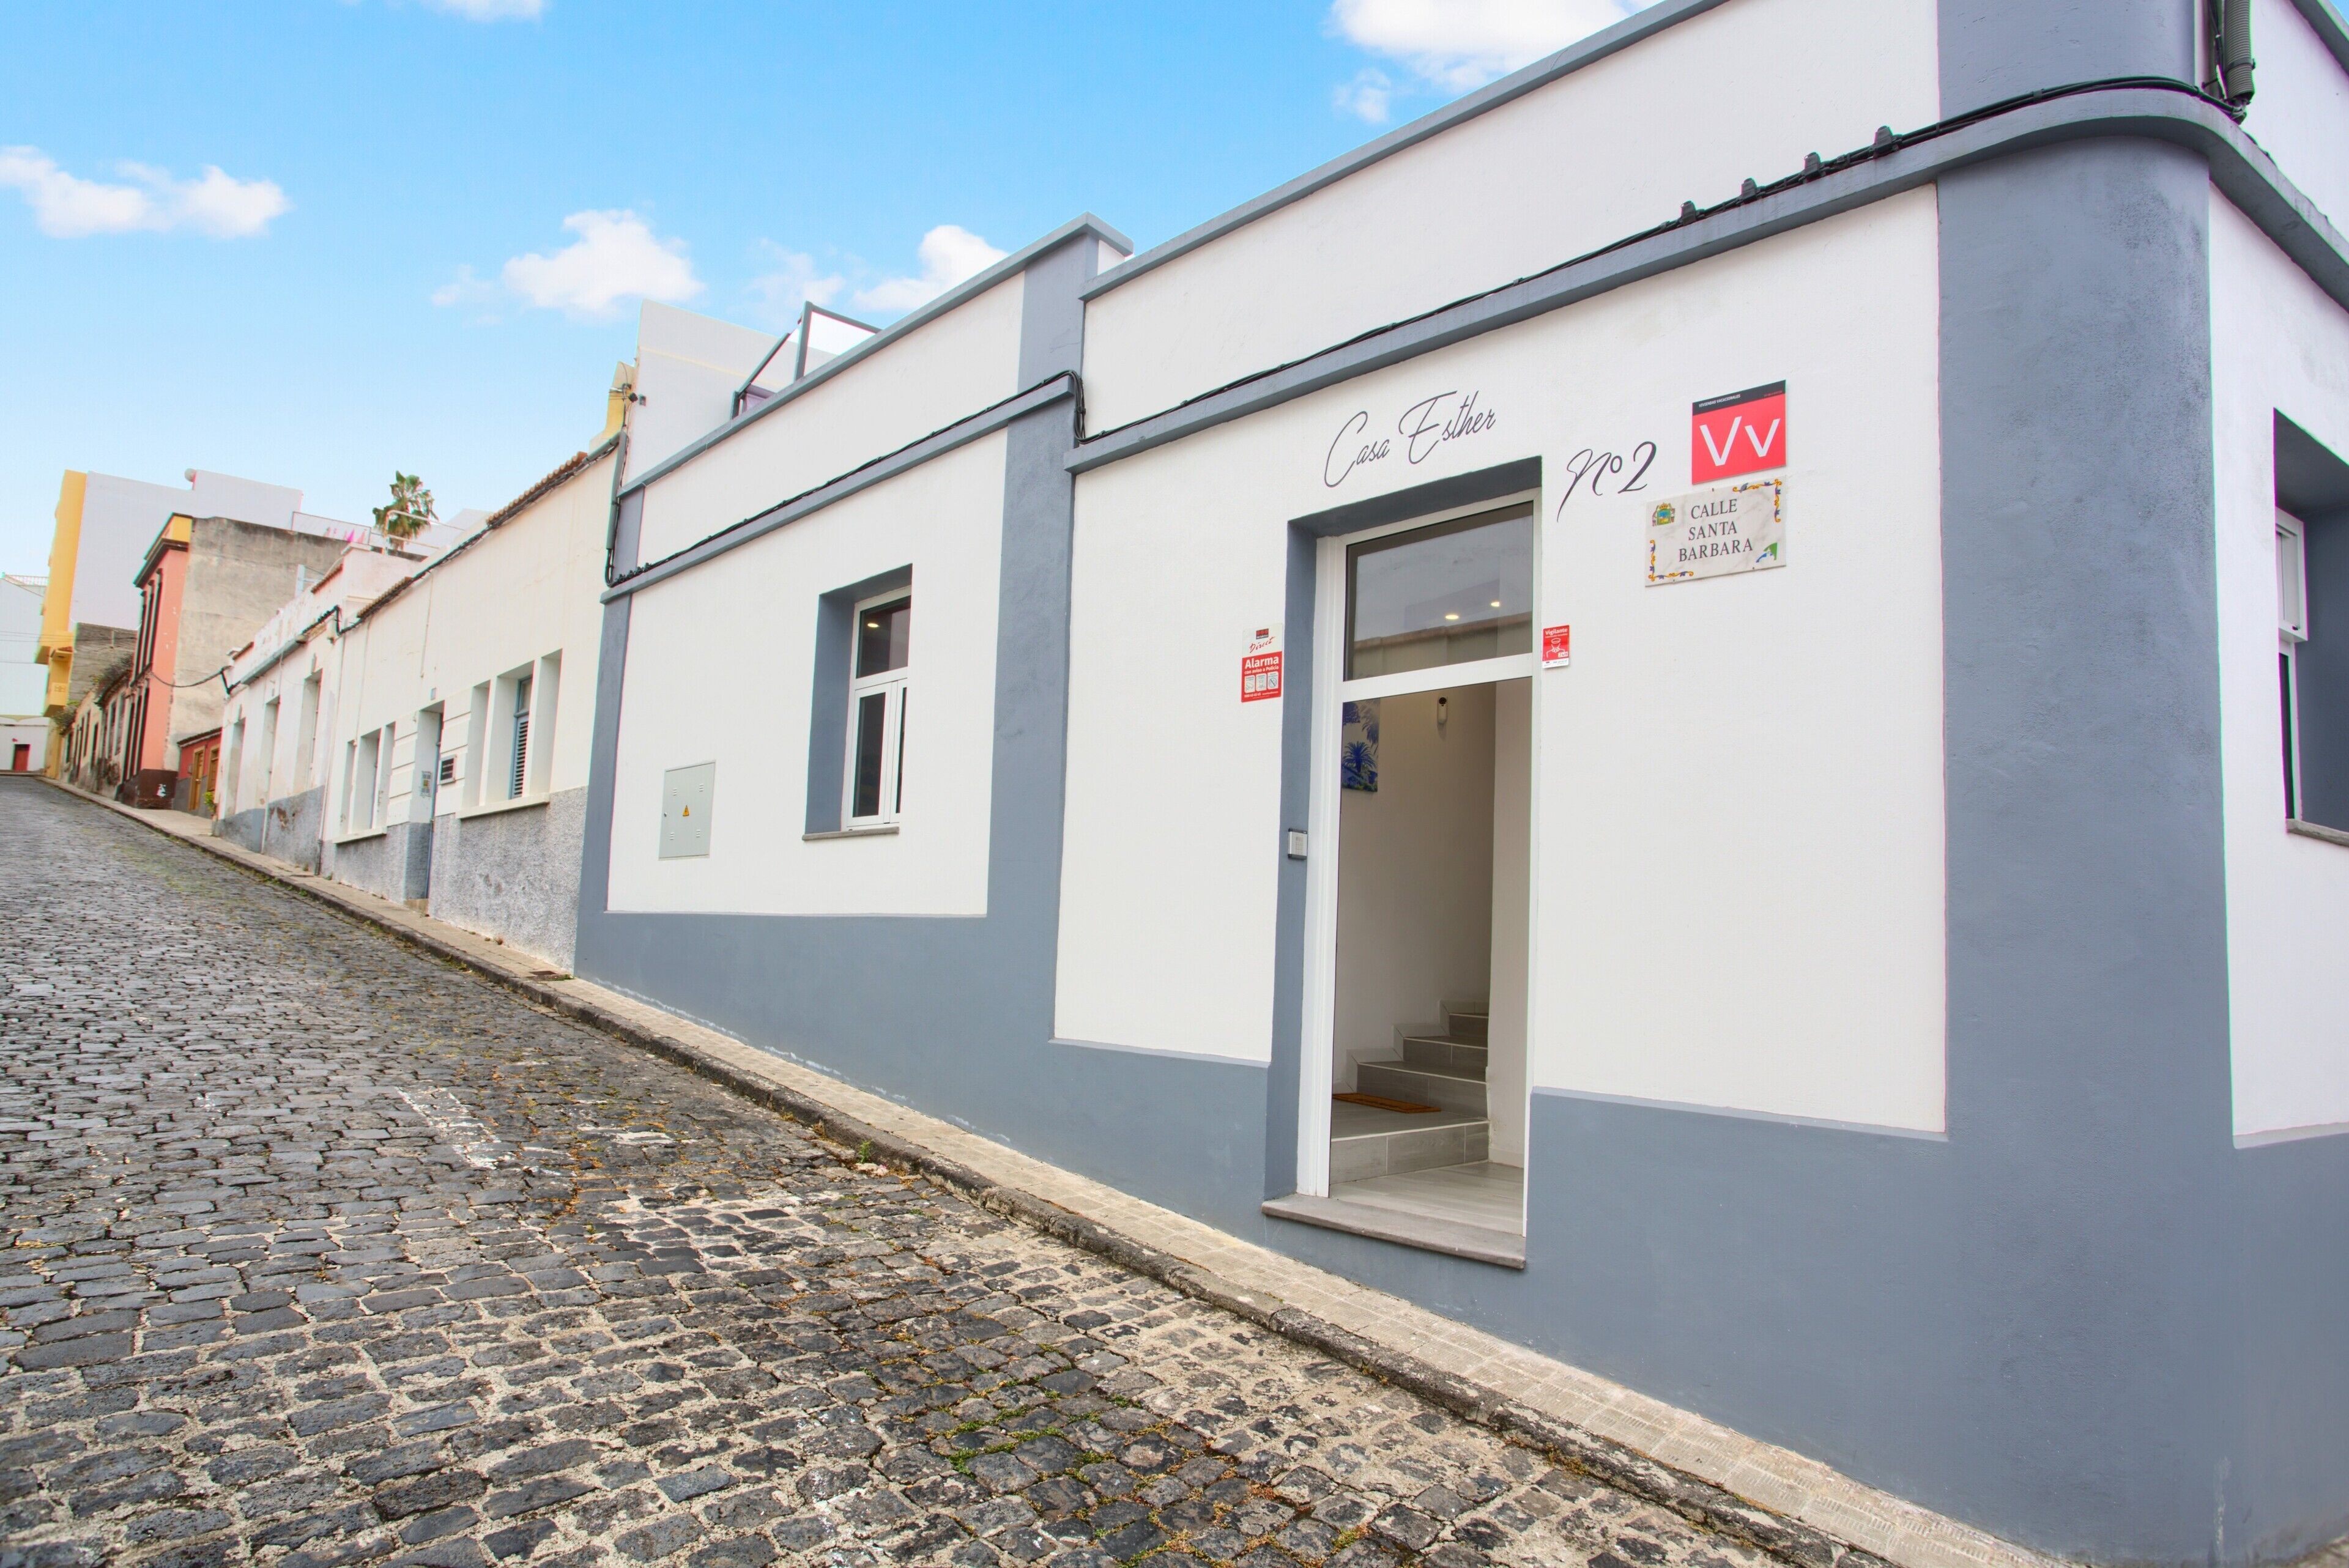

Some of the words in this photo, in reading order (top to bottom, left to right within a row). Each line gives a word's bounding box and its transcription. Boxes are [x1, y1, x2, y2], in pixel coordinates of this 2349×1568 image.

[1717, 394, 1740, 403] VACACIONALES
[1324, 411, 1390, 487] Casa
[1399, 390, 1496, 464] Esther
[1691, 498, 1738, 519] CALLE
[1688, 521, 1737, 541] SANTA
[1679, 538, 1753, 562] BARBARA
[1249, 636, 1275, 653] Direct
[1245, 656, 1279, 669] Alarma
